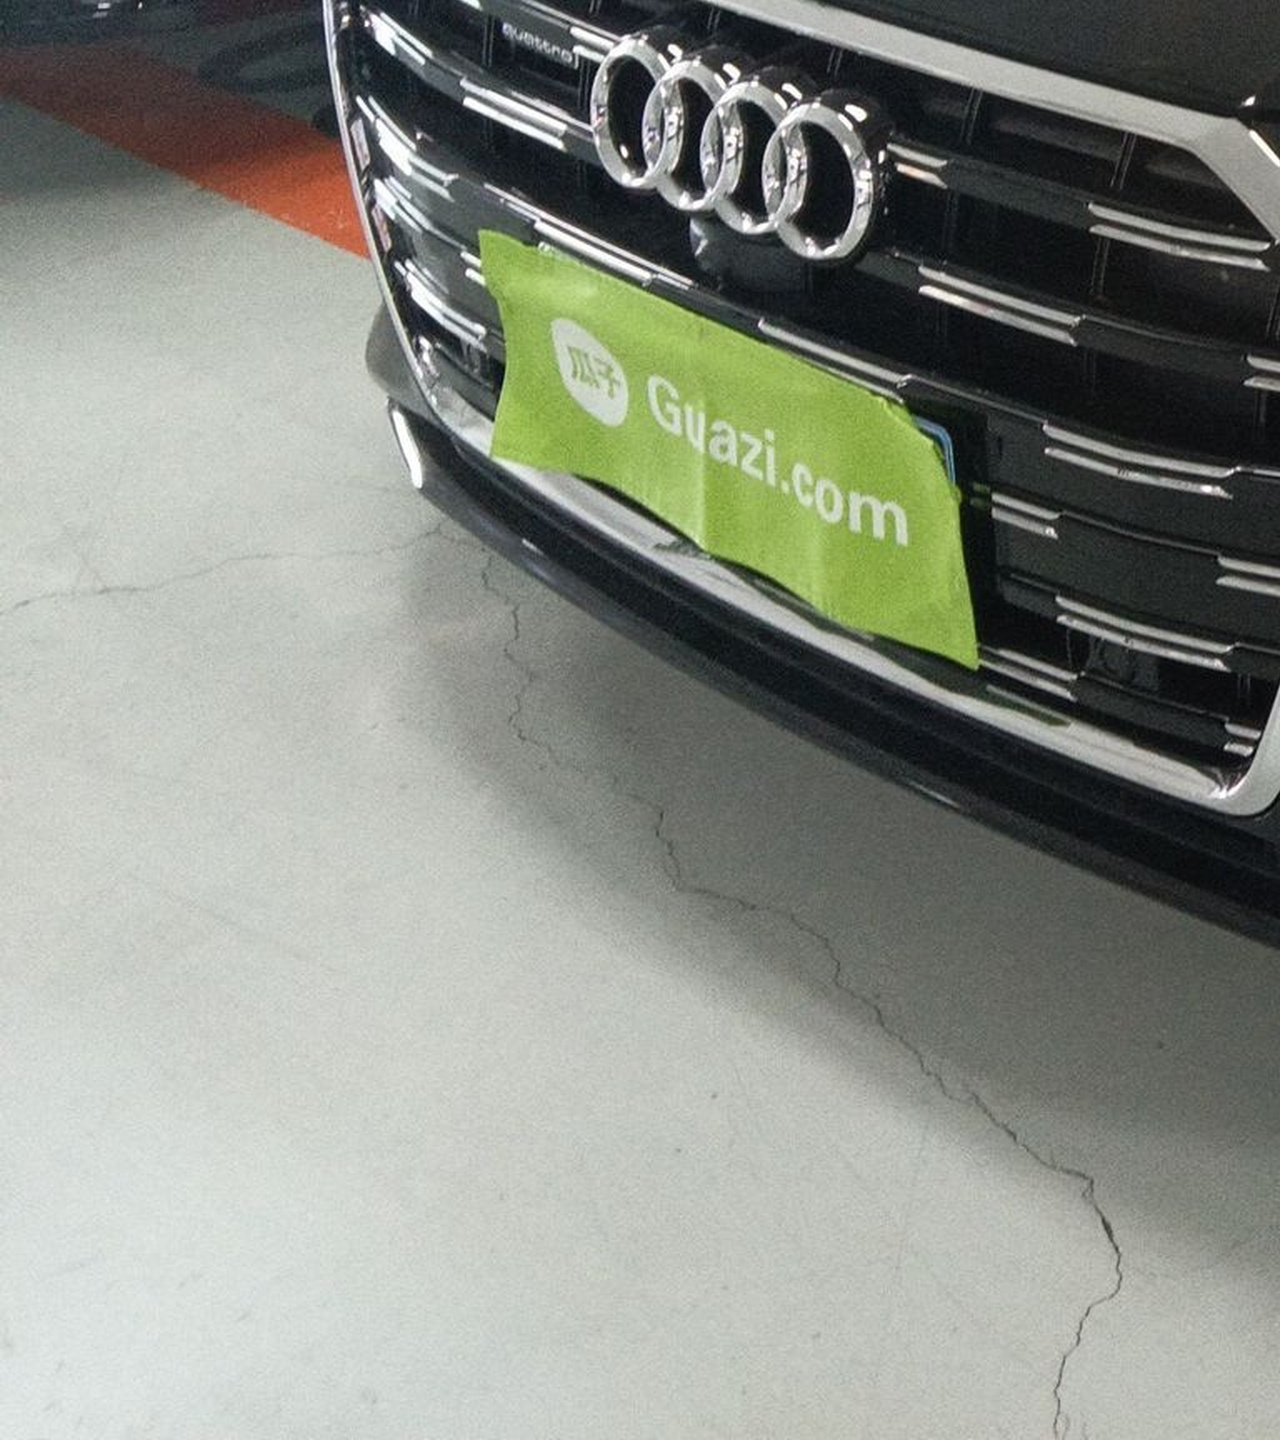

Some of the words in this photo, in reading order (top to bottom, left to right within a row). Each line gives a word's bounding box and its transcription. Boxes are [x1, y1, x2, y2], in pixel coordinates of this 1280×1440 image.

[501, 21, 574, 64] quattro
[567, 345, 622, 399] 瓜子
[645, 372, 909, 548] Guazi.com
